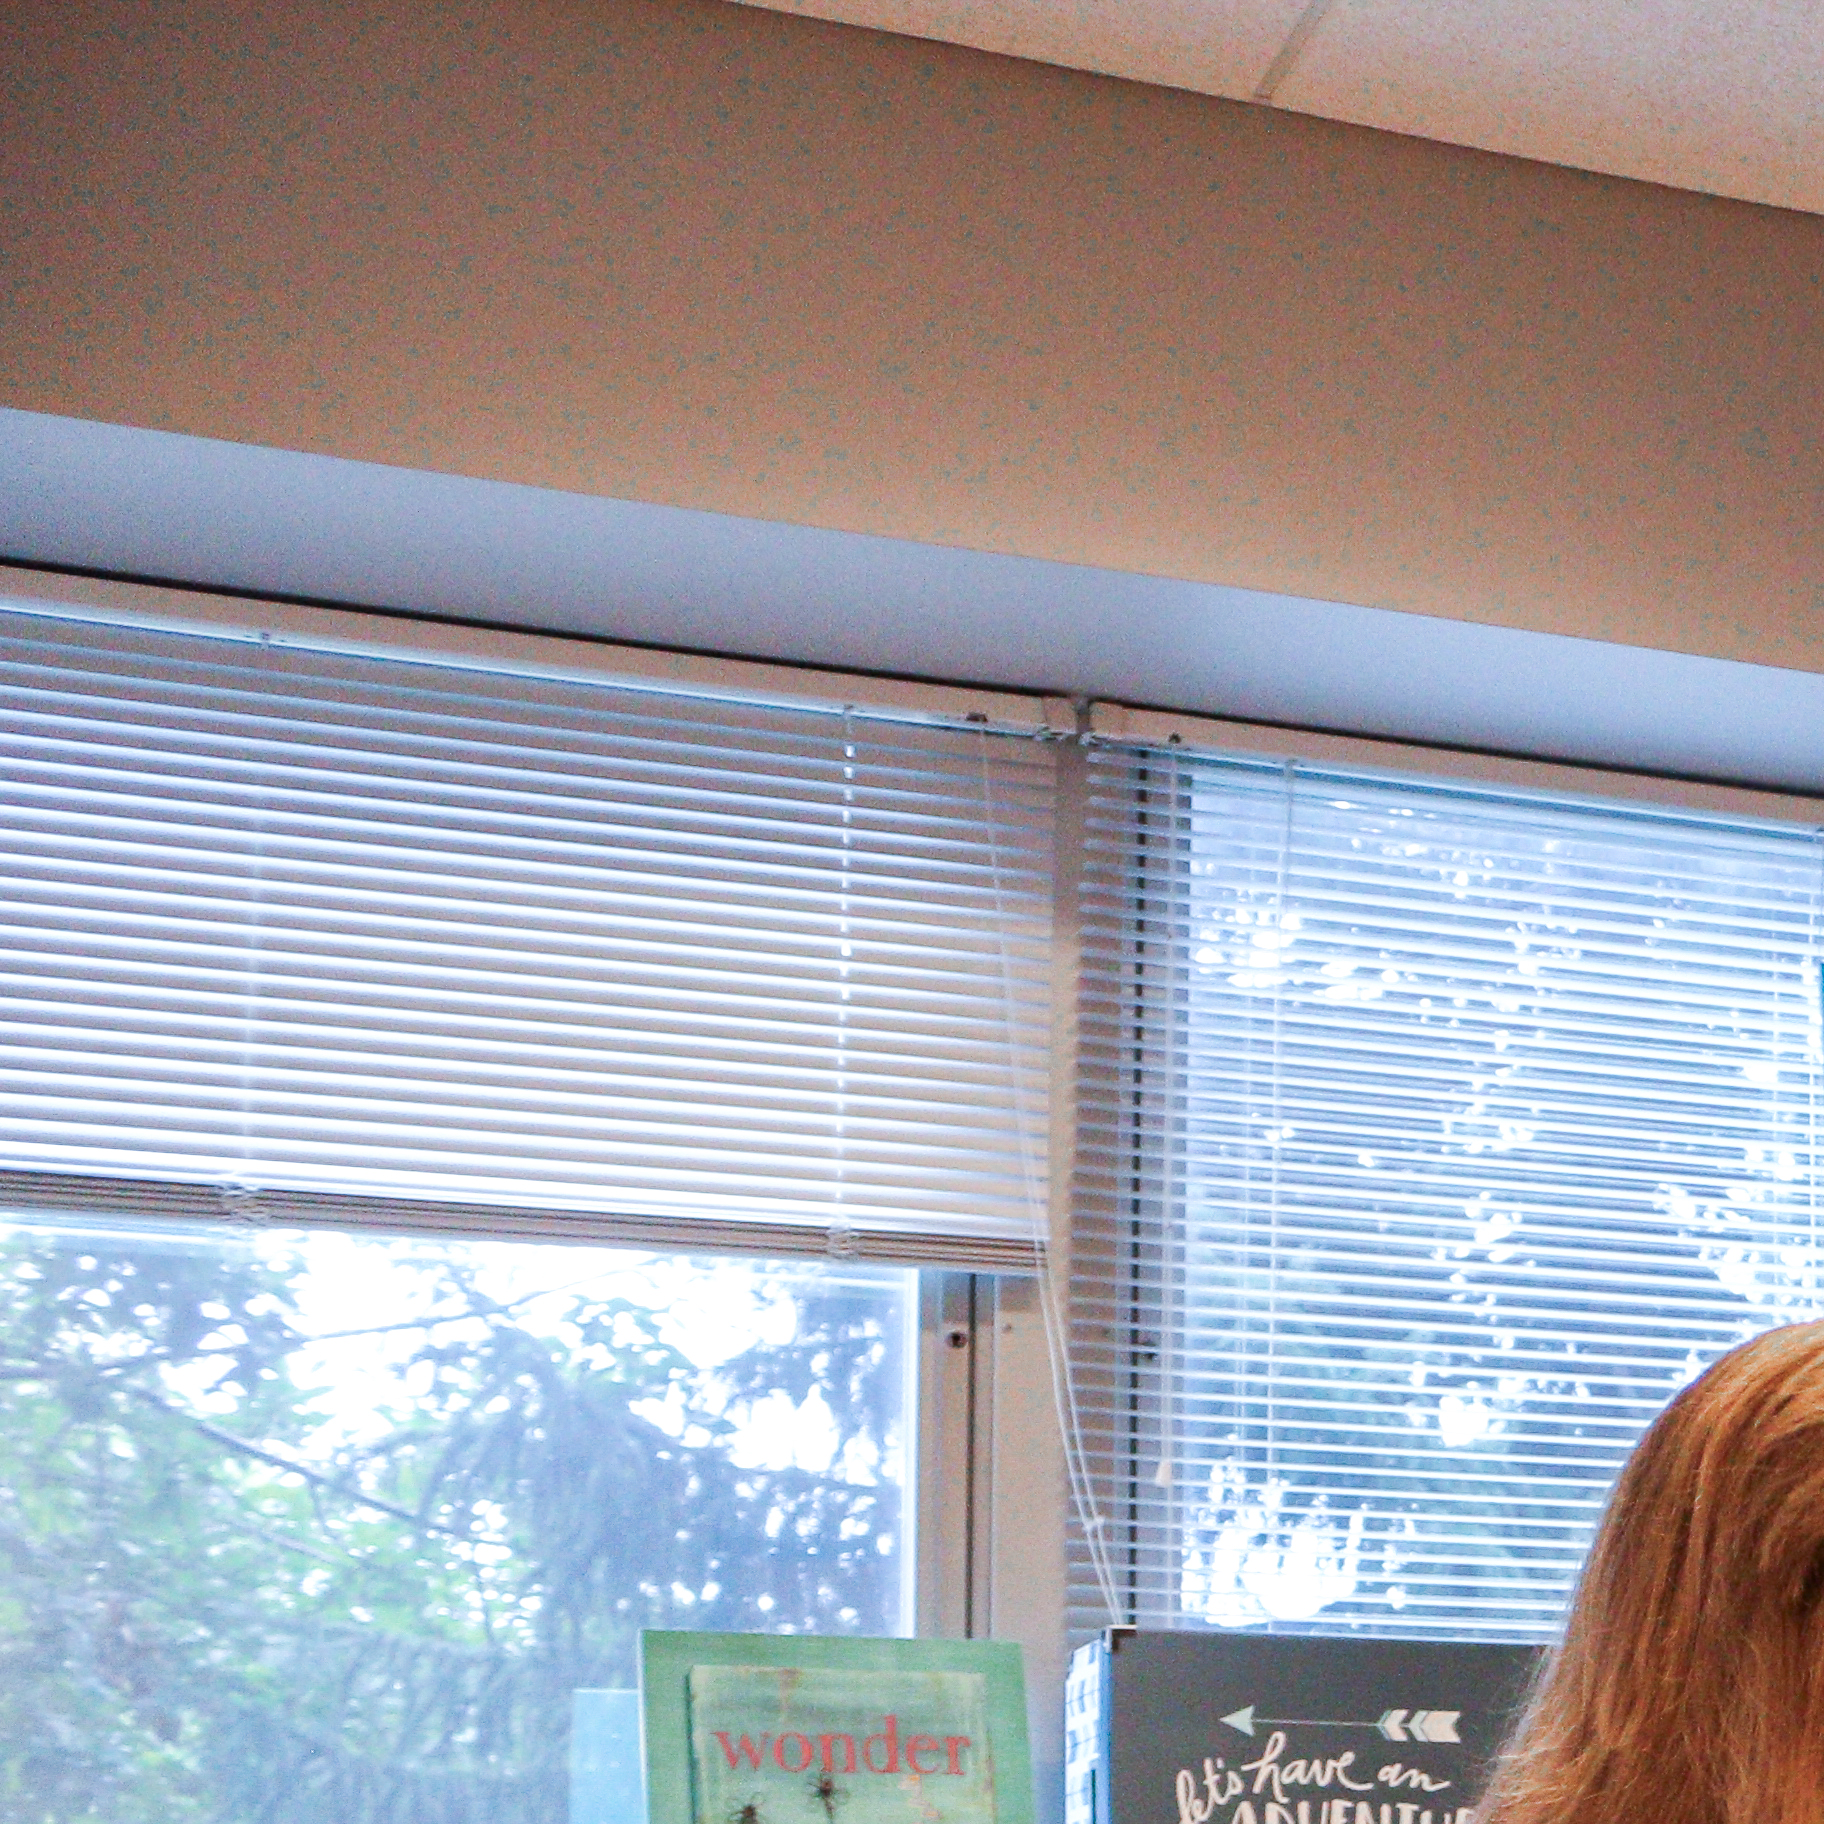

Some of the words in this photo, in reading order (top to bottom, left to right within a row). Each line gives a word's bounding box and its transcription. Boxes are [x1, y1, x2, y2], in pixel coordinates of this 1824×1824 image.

[710, 1714, 972, 1777] wonder
[1240, 1730, 1374, 1804] have
[1376, 1761, 1451, 1793] an
